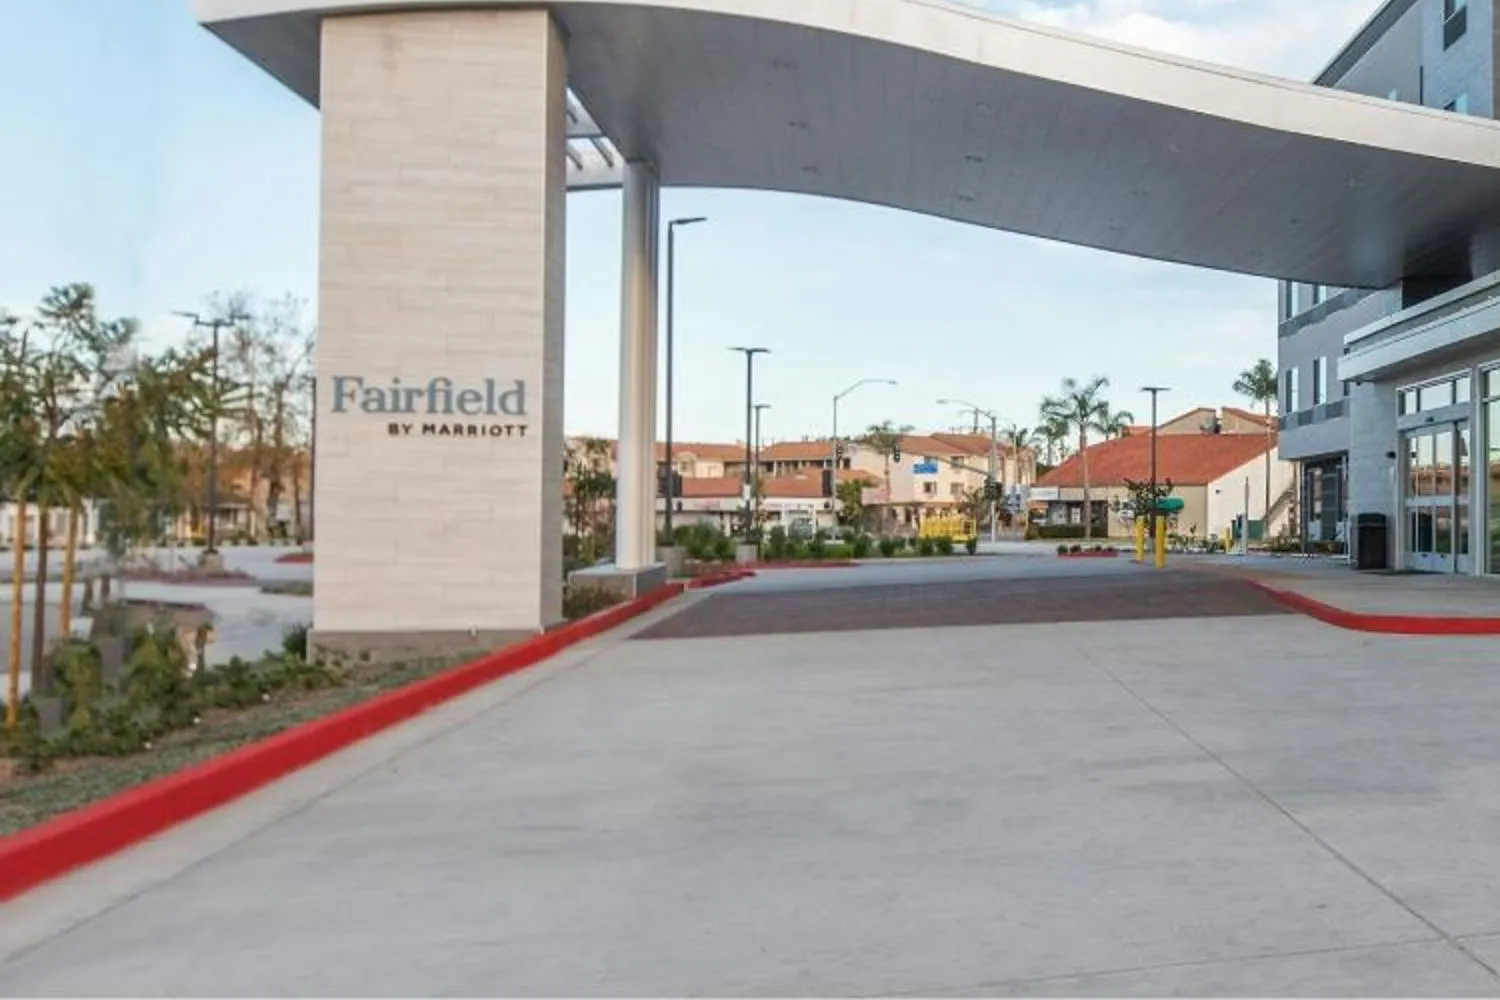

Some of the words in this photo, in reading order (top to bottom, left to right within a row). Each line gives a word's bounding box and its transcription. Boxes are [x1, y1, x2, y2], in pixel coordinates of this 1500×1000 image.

[331, 375, 528, 415] Fairfield
[388, 423, 413, 436] BY
[422, 423, 528, 438] MARRIOTT
